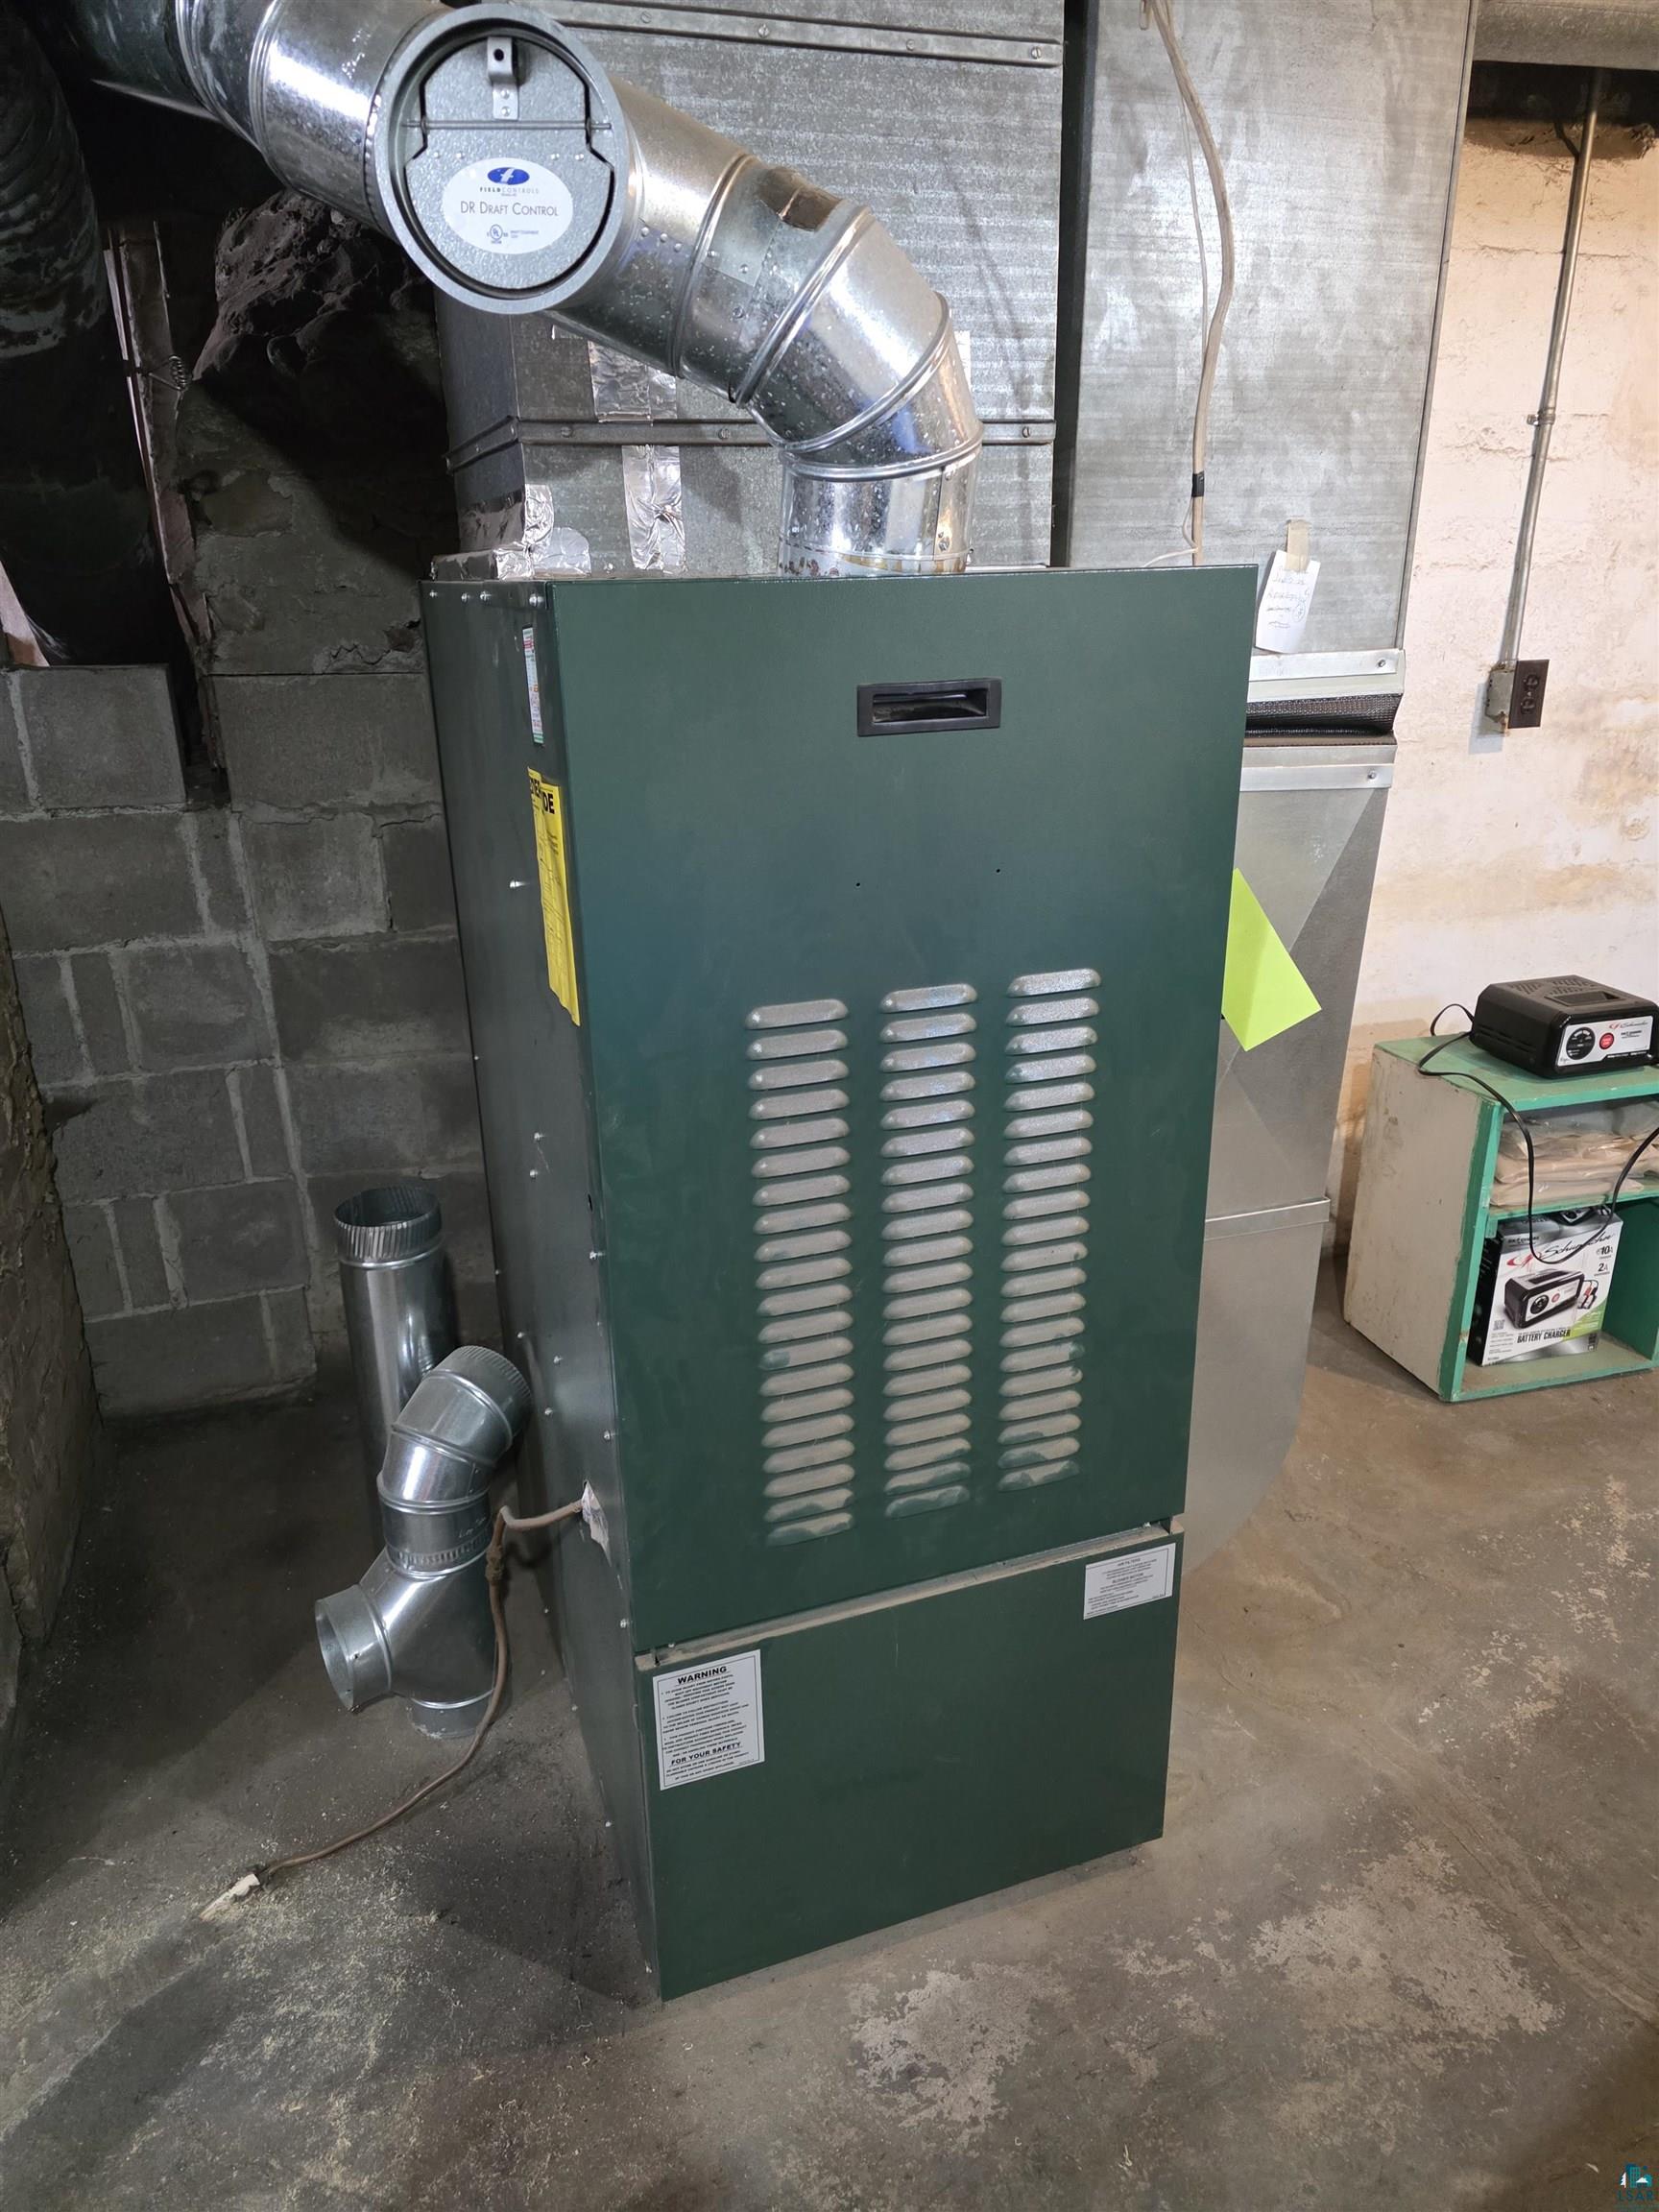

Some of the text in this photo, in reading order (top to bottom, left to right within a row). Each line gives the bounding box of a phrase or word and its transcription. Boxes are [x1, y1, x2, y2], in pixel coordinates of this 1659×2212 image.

[461, 201, 475, 213] DR
[513, 203, 559, 216] CONTROL
[1517, 1334, 1542, 1343] BATTERY
[1543, 1329, 1571, 1339] CHARGER
[677, 1666, 727, 1684] WARNING
[671, 1742, 741, 1766] FOR YOUR SAFETY
